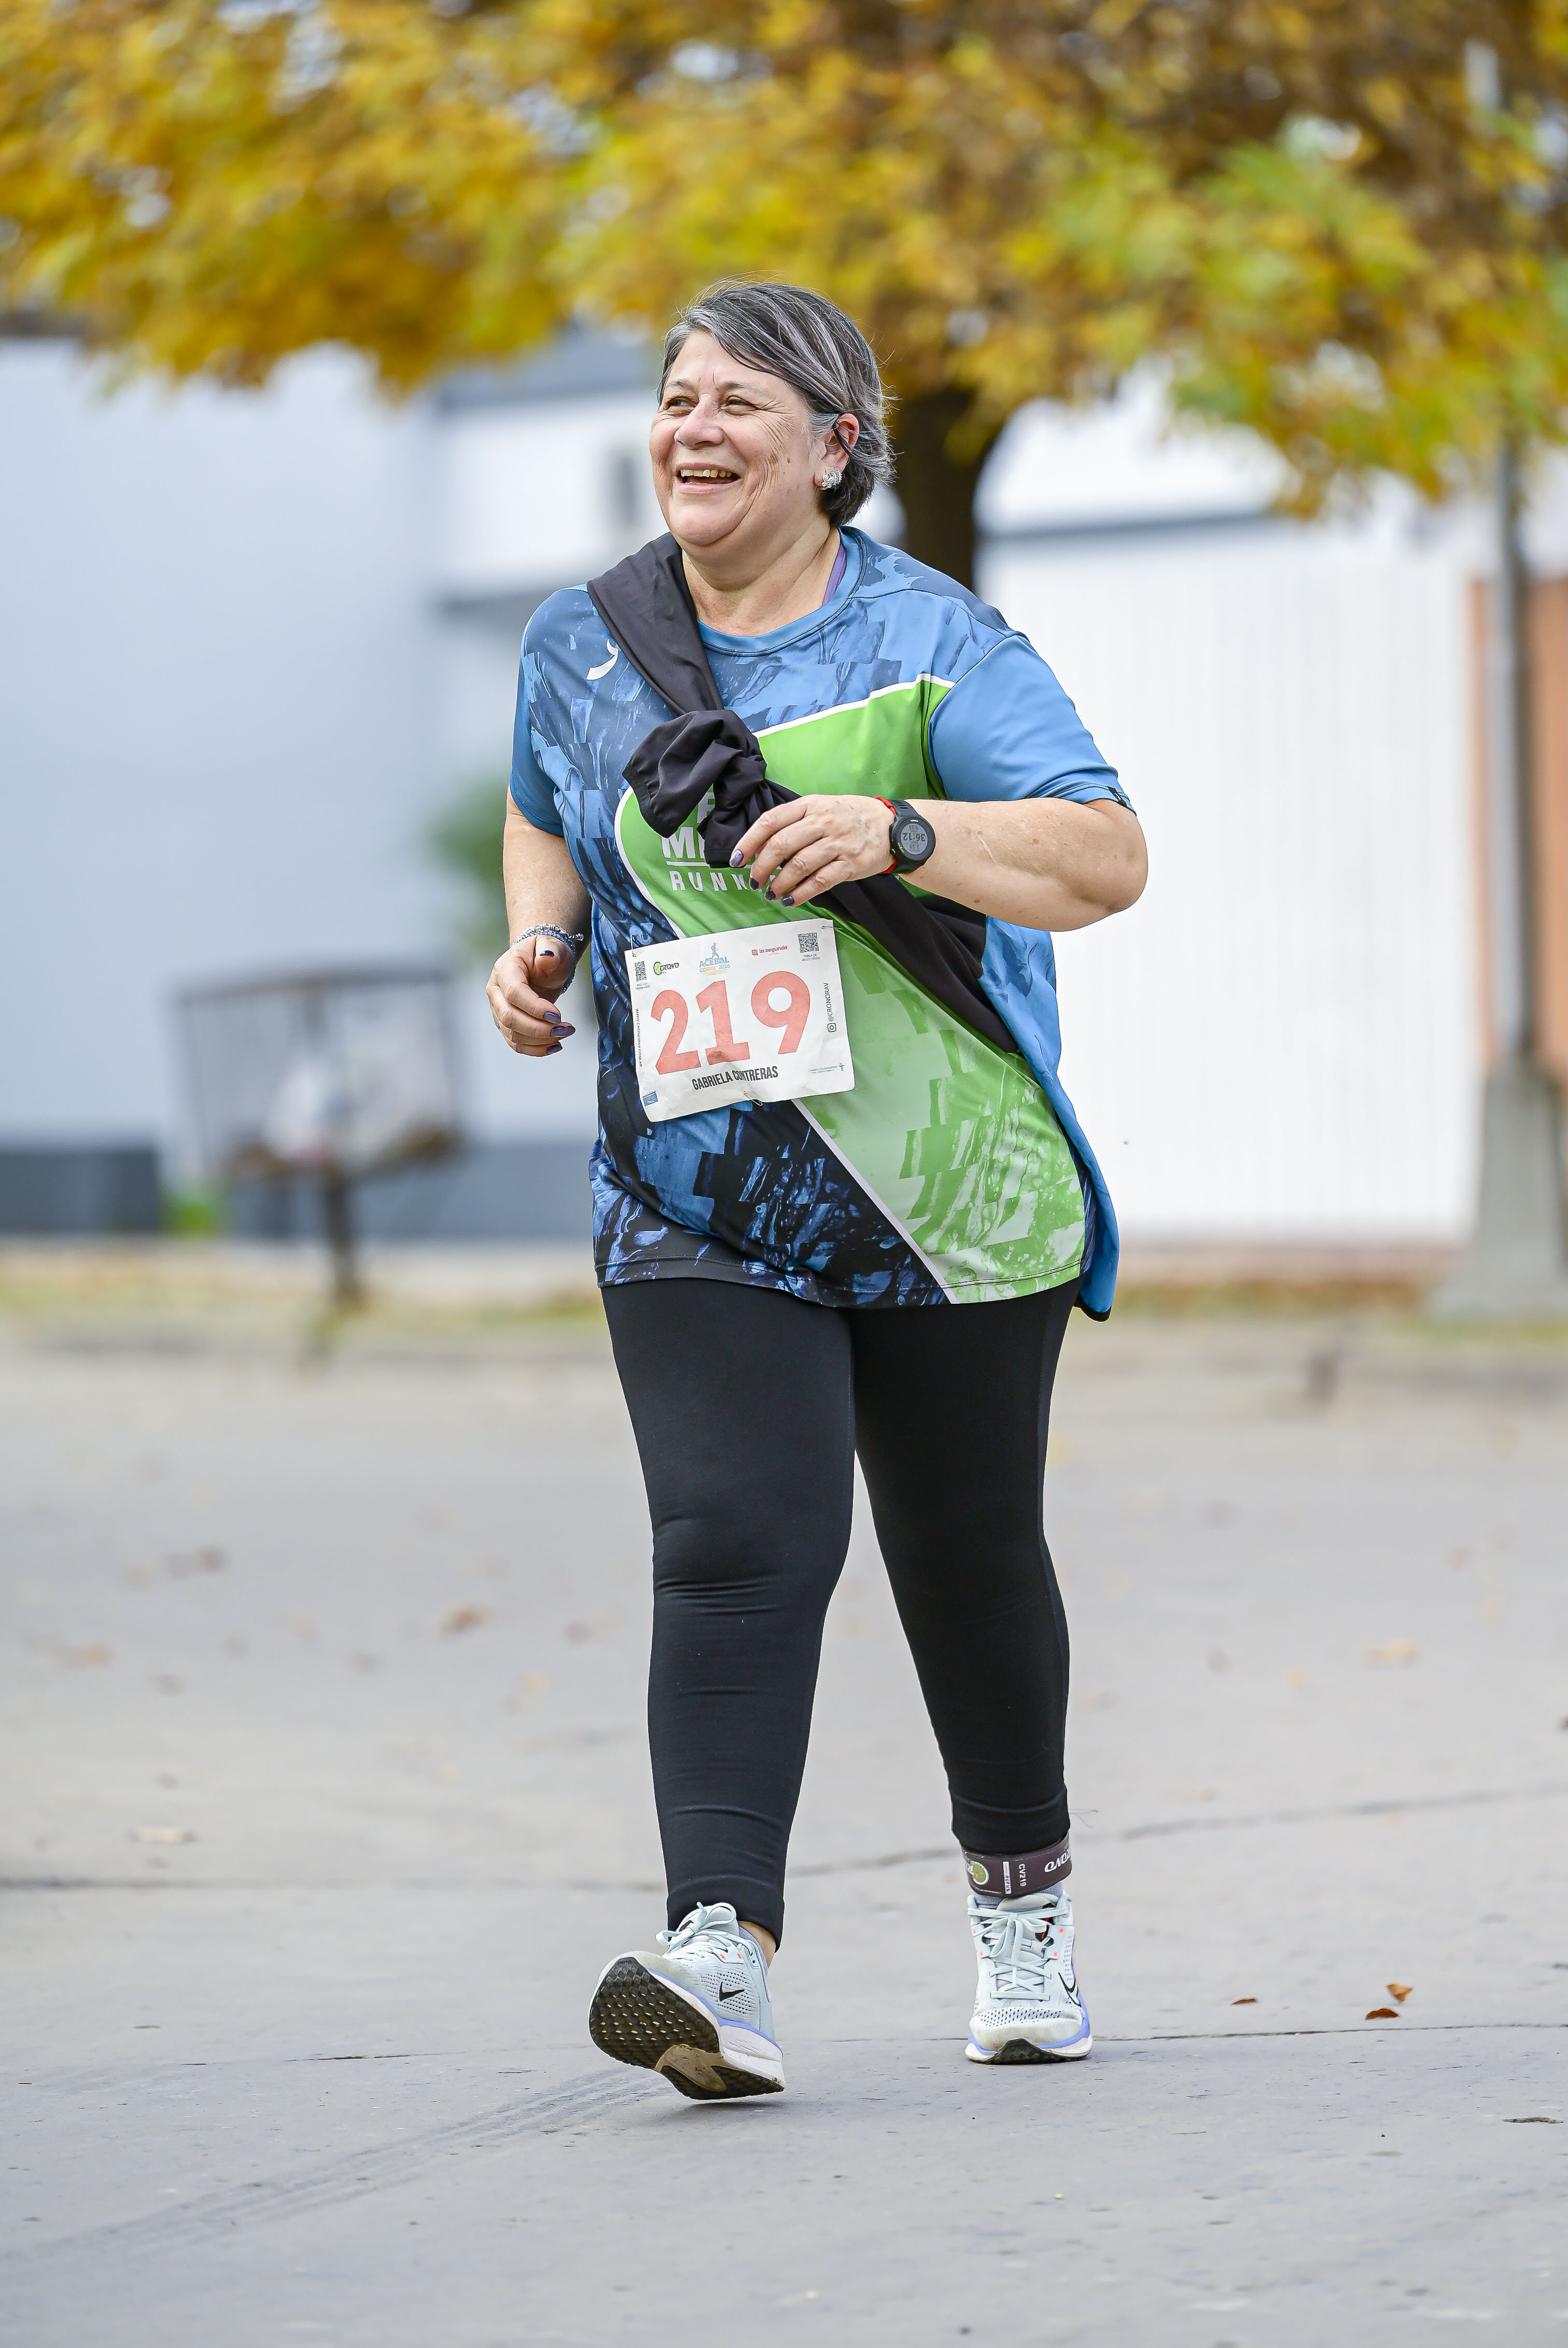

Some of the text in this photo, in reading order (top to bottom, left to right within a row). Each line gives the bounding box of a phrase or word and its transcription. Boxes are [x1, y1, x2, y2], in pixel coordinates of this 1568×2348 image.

[903, 832, 926, 842] 36:12
[699, 956, 730, 968] ACEBAL
[823, 983, 834, 1022] @CRONORAV
[651, 971, 810, 1075] 219
[692, 1071, 733, 1091] GABRIELA
